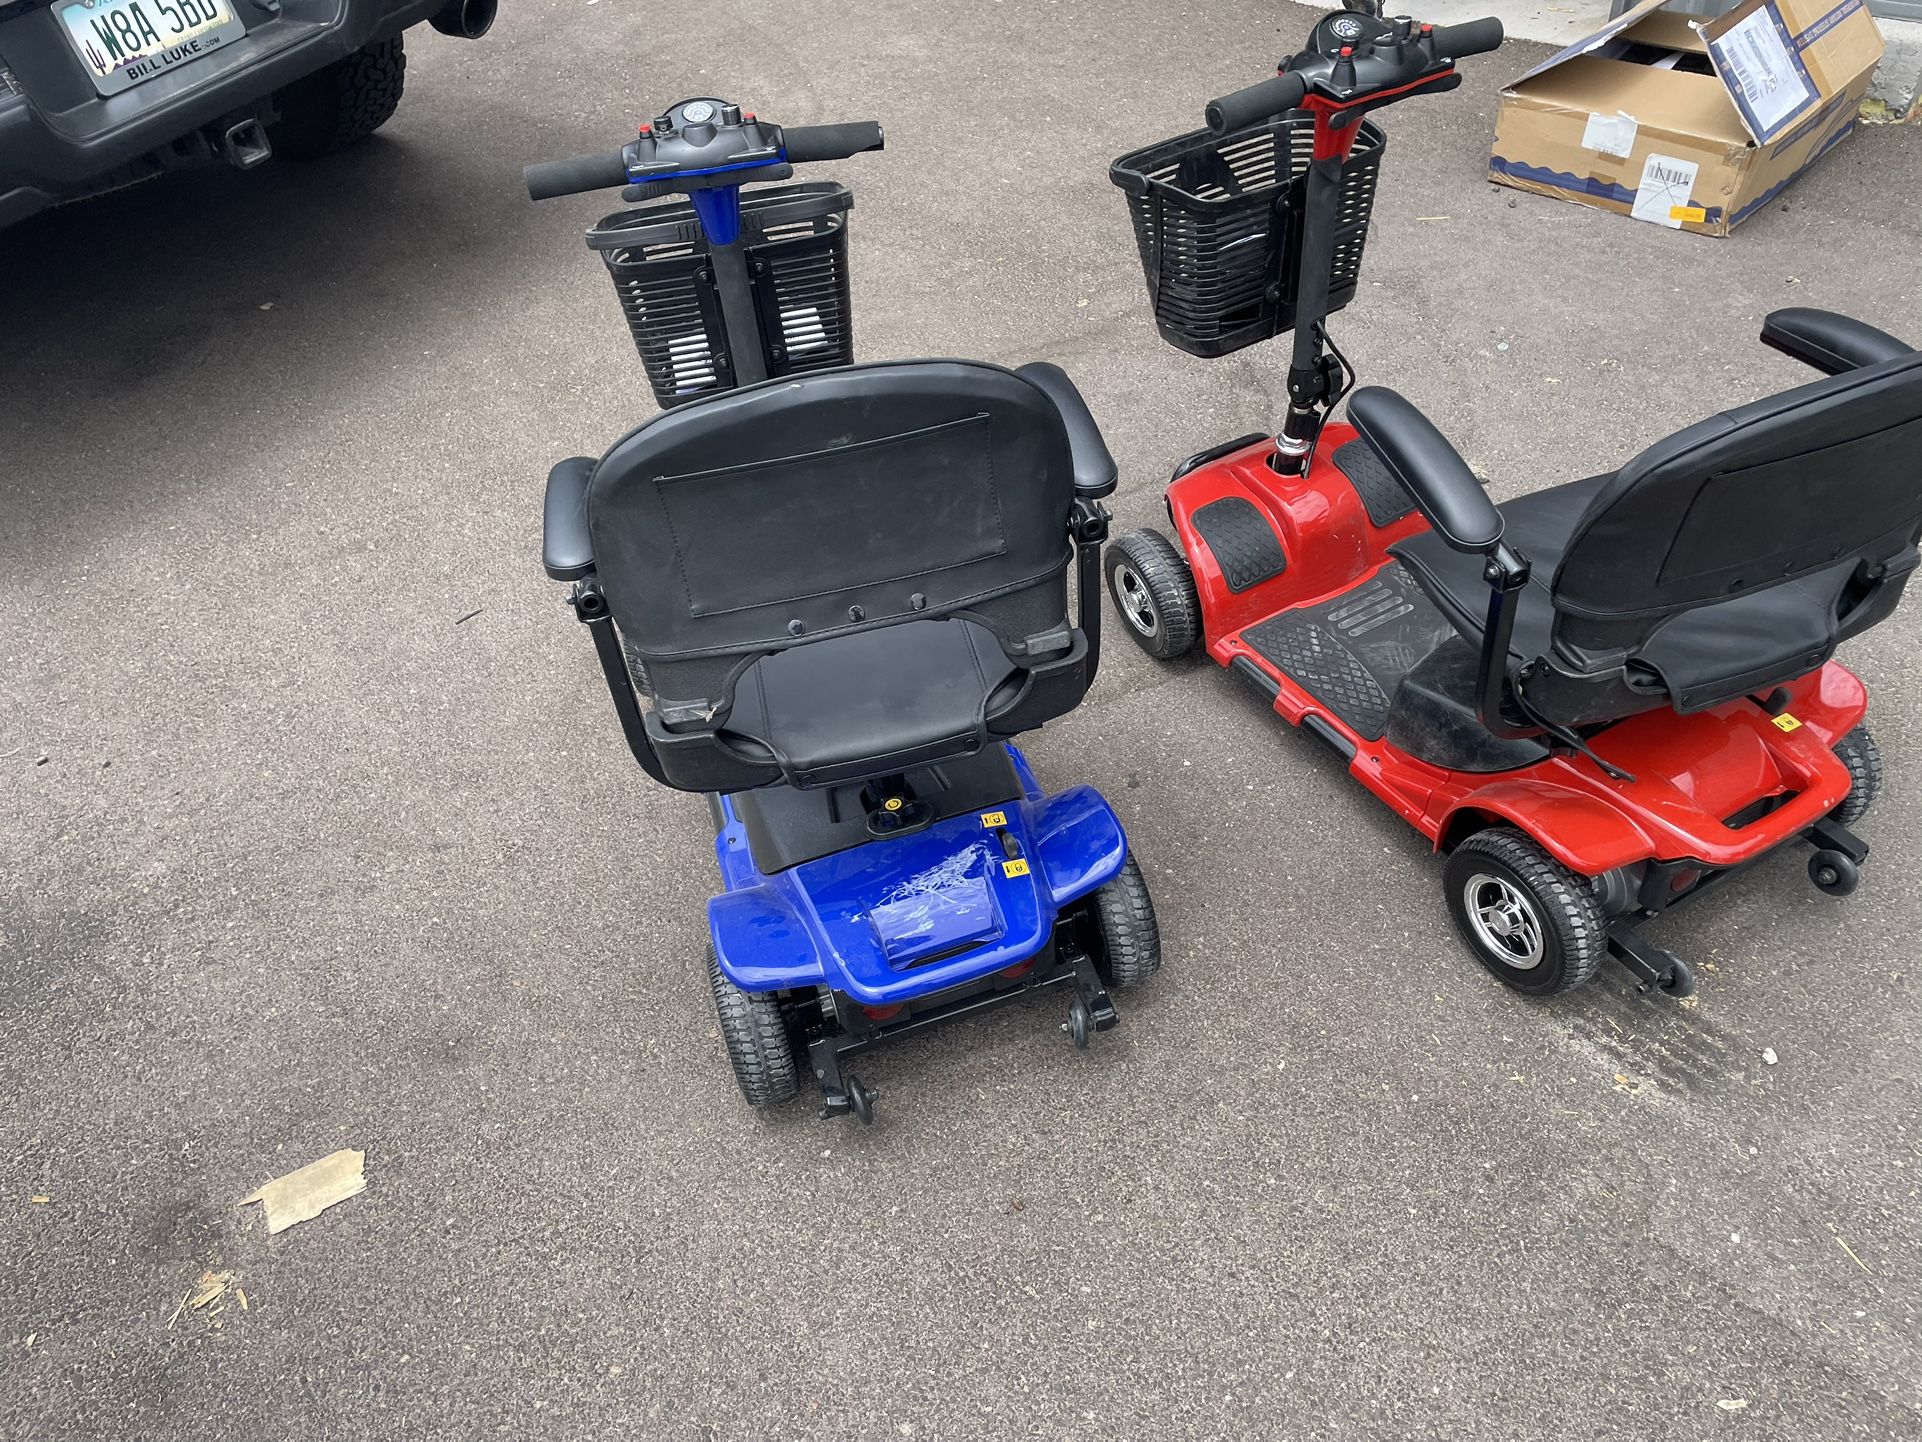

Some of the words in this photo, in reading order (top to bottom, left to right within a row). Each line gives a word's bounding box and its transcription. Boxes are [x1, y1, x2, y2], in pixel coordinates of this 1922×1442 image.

[90, 1, 161, 61] W8A
[126, 58, 162, 80] BILL
[161, 40, 202, 65] LUKE
